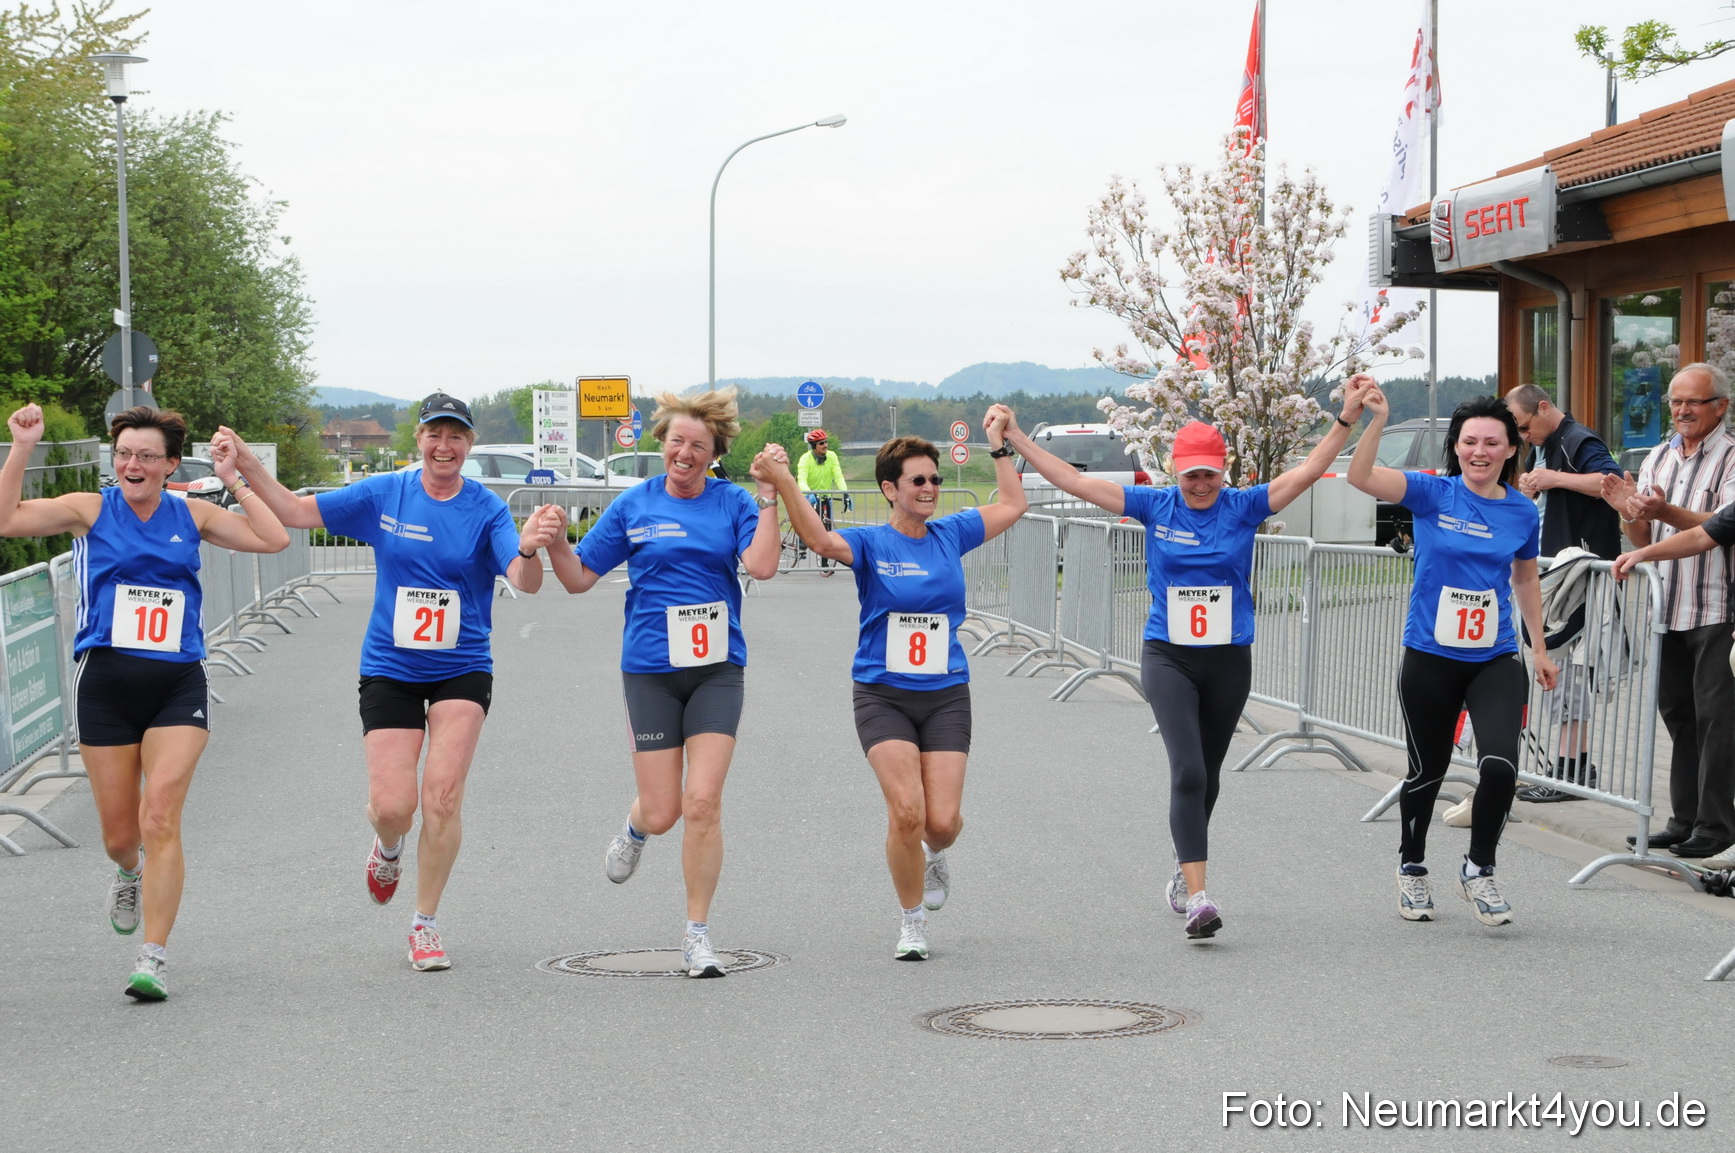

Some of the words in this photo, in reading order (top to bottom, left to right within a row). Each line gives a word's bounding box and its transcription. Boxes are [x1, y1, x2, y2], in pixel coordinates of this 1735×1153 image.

[1465, 196, 1529, 239] SEAT
[584, 393, 625, 403] Neumarkt
[954, 426, 965, 437] 60
[531, 476, 552, 485] VOLVO
[128, 588, 160, 598] MEYER
[407, 590, 437, 599] MEYER
[1178, 589, 1207, 597] MEYER
[1451, 591, 1481, 602] MEYER
[128, 596, 160, 604] WERBUNG
[407, 597, 437, 605] WERBUNG
[1451, 599, 1481, 608] WERBUNG
[678, 607, 708, 617] MEYER
[135, 606, 168, 643] 10
[413, 607, 445, 643] 21
[1190, 604, 1207, 638] 6
[1456, 608, 1486, 641] 13
[691, 623, 709, 658] 9
[908, 631, 927, 666] 8
[636, 732, 664, 742] ODLO
